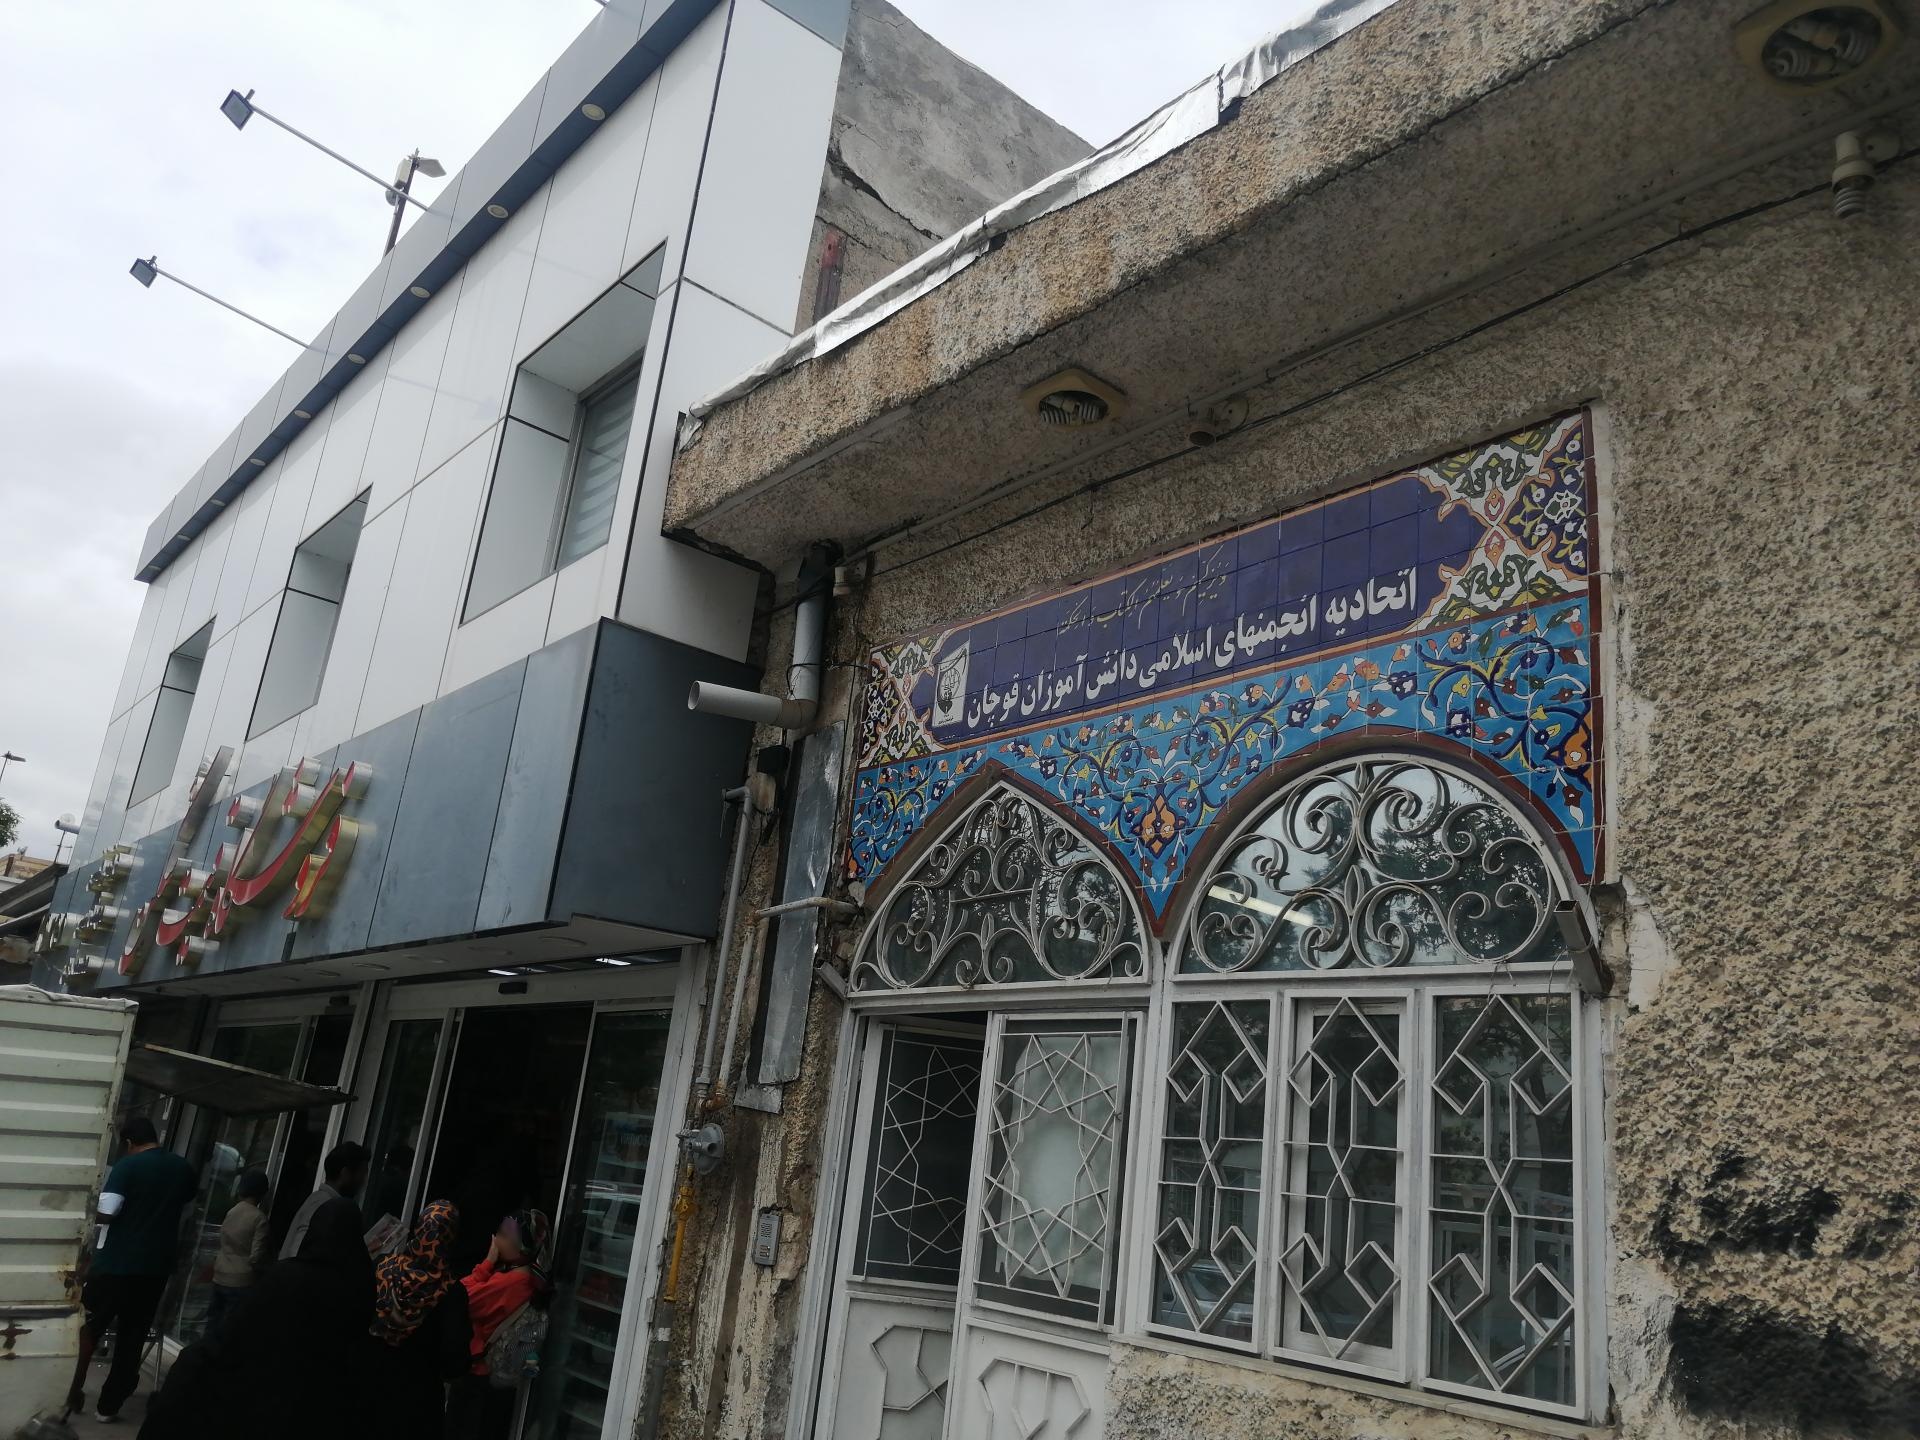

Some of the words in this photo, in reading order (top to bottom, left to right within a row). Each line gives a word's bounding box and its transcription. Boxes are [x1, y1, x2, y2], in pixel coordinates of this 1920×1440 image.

[1215, 594, 1317, 668] انجمنهای
[1325, 566, 1417, 636] اتحادیه
[1021, 653, 1088, 716] آموزان
[1086, 649, 1137, 700] دانش
[1139, 627, 1212, 688] اسلامی
[968, 673, 1019, 728] قوچان
